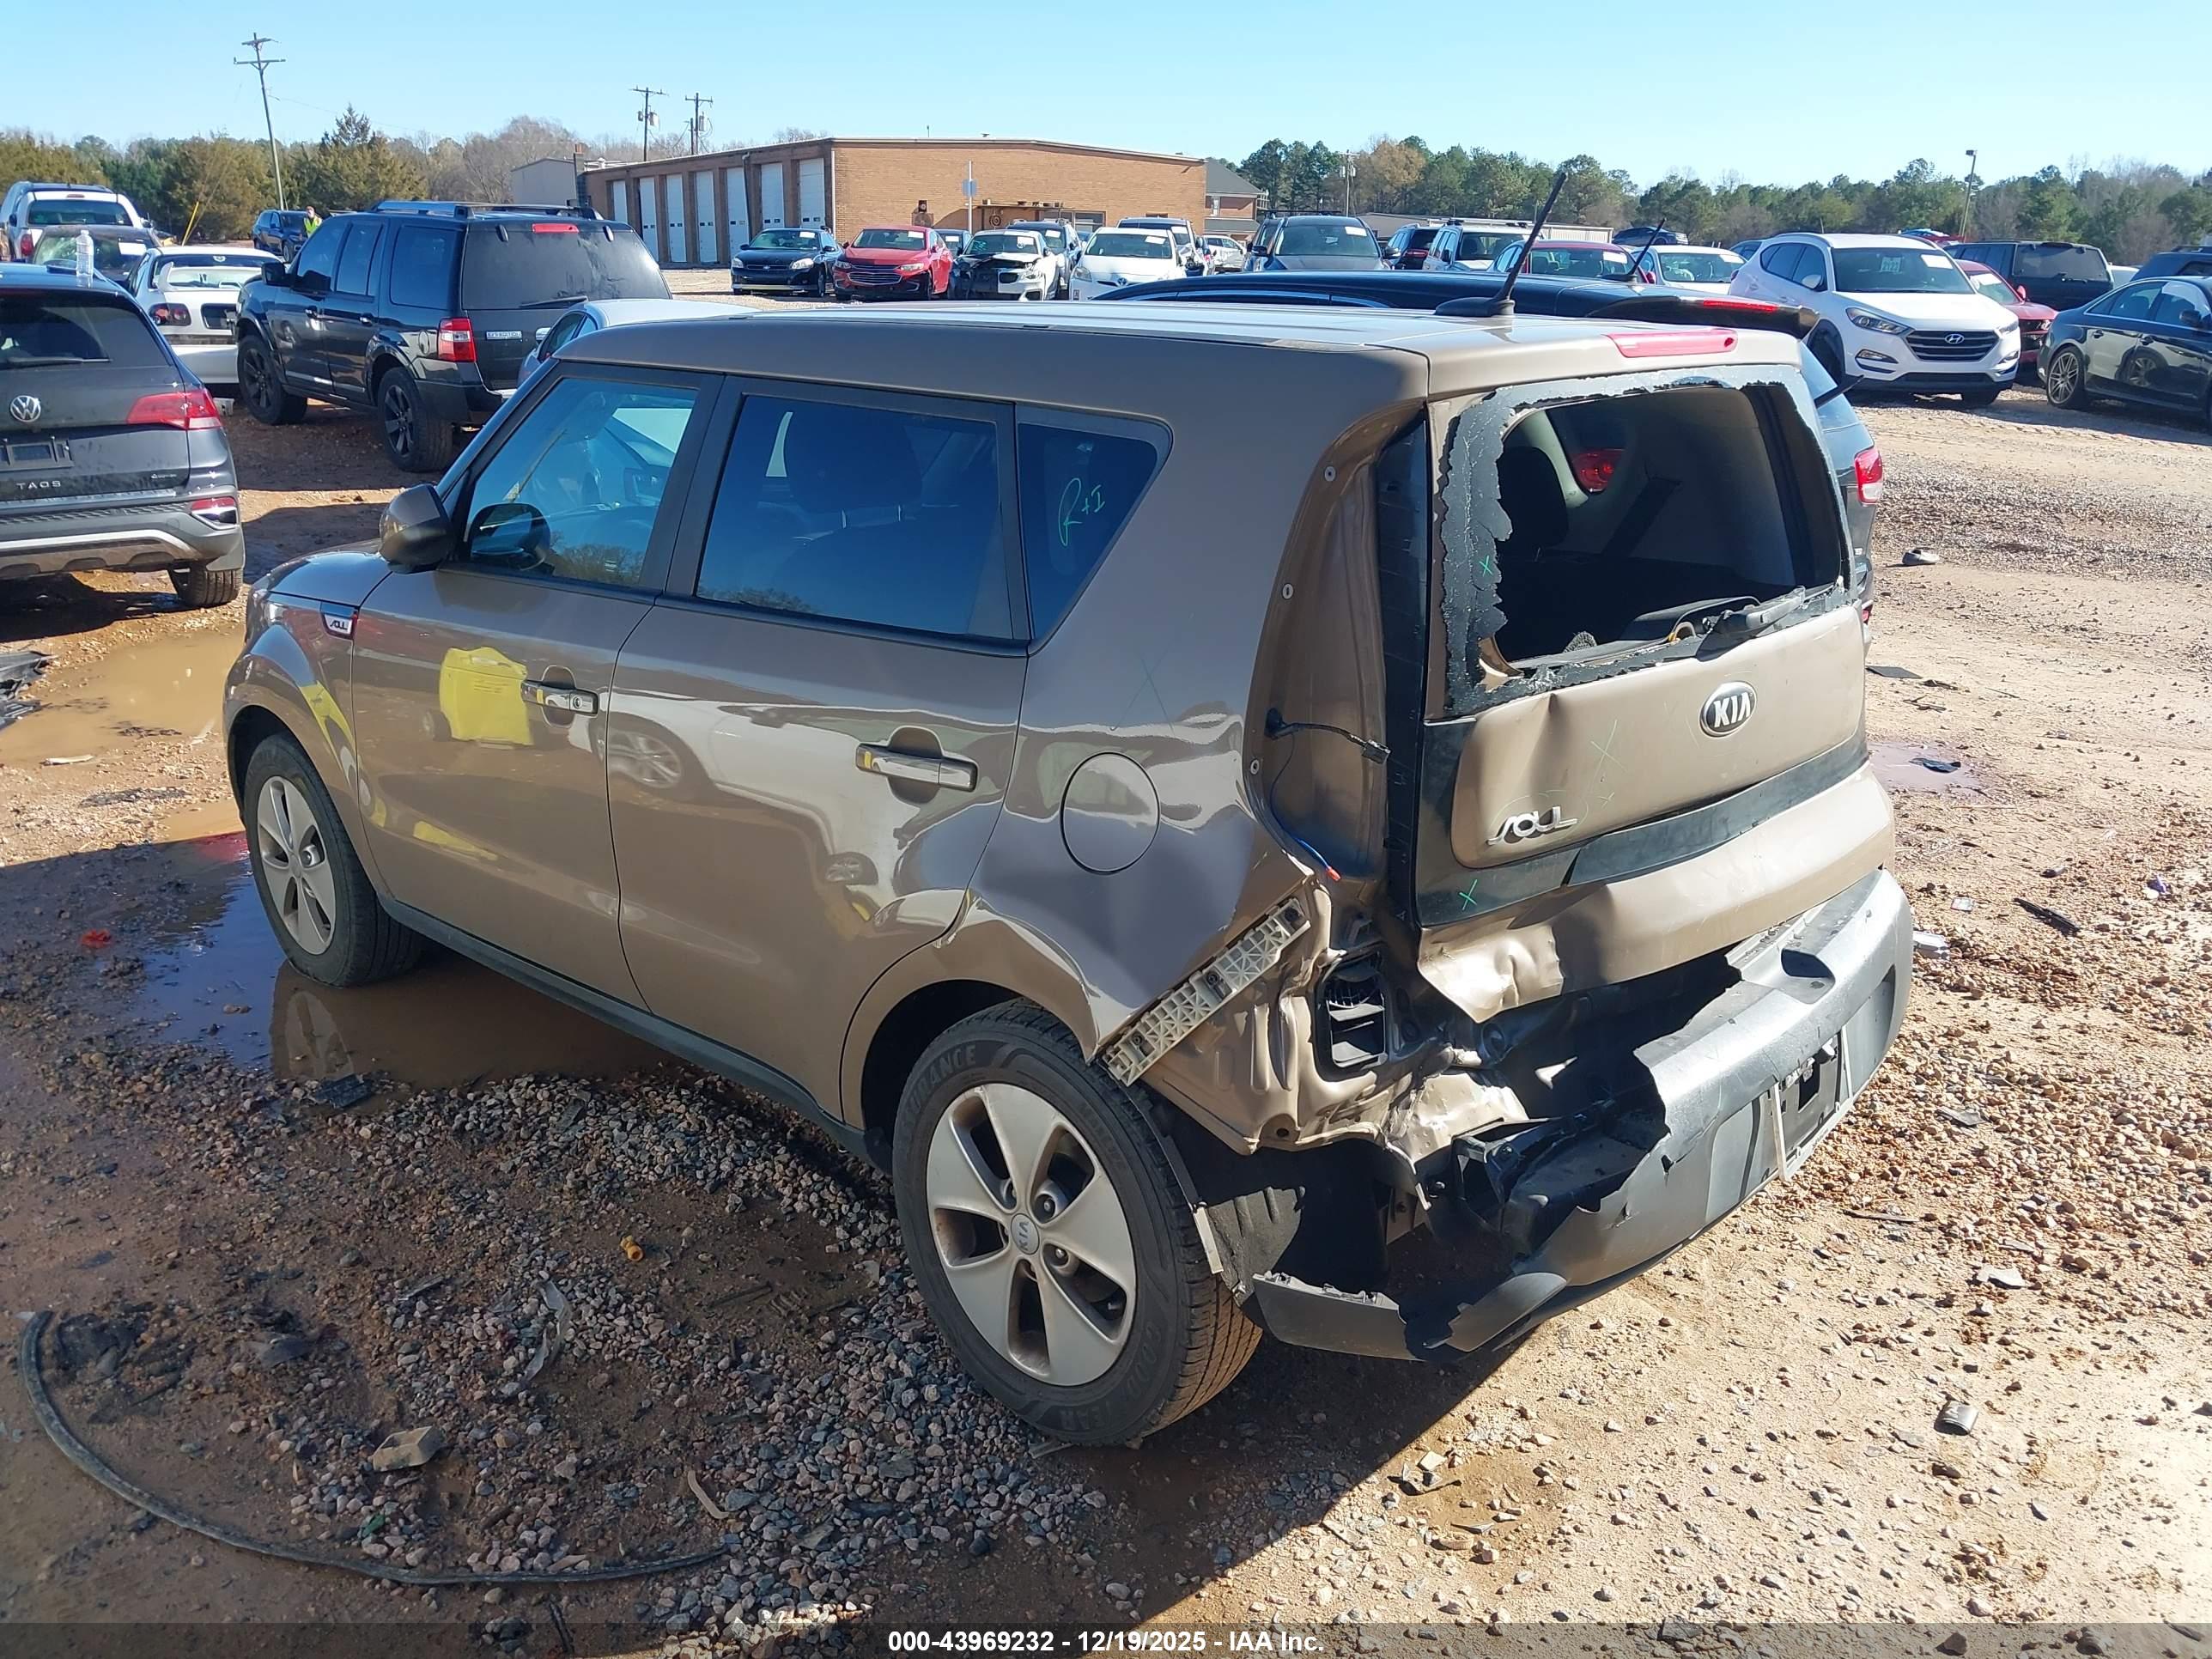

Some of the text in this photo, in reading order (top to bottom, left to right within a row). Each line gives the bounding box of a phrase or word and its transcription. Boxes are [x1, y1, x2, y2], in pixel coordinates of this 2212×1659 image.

[16, 480, 62, 491] TAOS
[1713, 692, 1751, 728] KIA
[1486, 806, 1578, 846] SOUL
